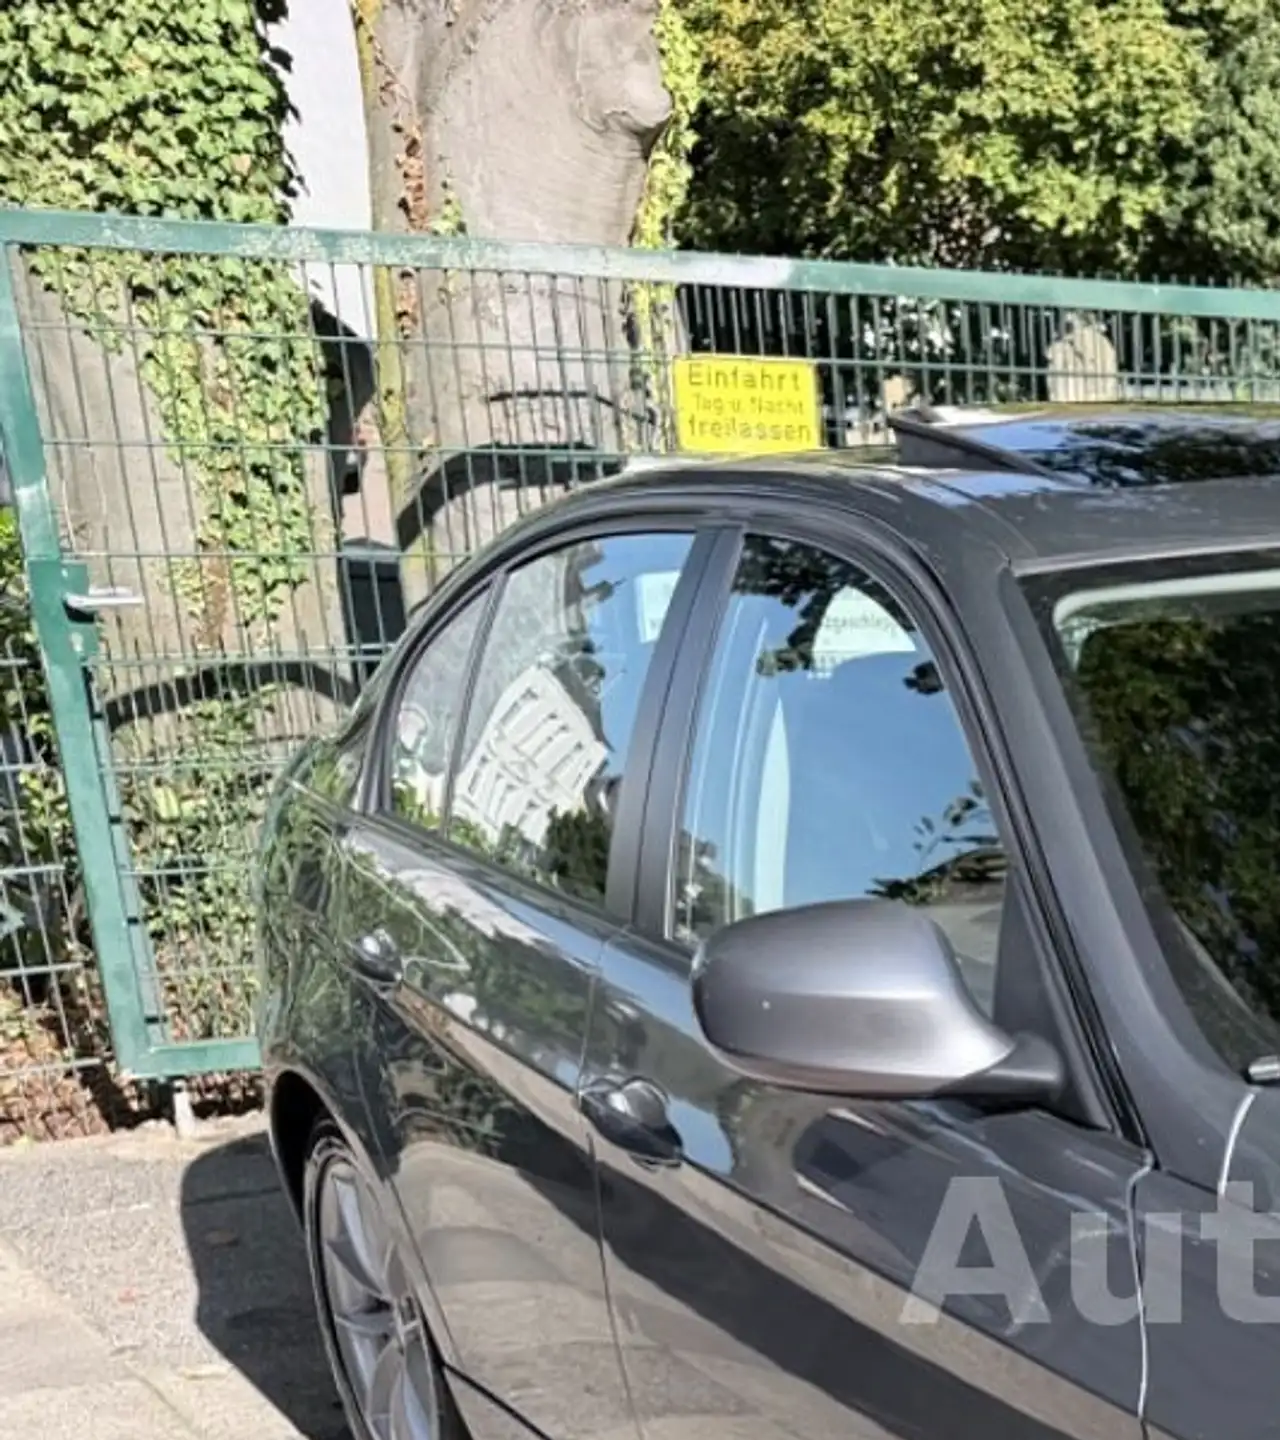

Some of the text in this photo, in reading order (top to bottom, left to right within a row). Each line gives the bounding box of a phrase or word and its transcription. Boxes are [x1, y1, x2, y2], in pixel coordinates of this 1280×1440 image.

[688, 364, 801, 391] Einfahrt
[693, 393, 724, 415] Tag
[749, 396, 804, 415] Nacht
[689, 415, 811, 442] freilassen
